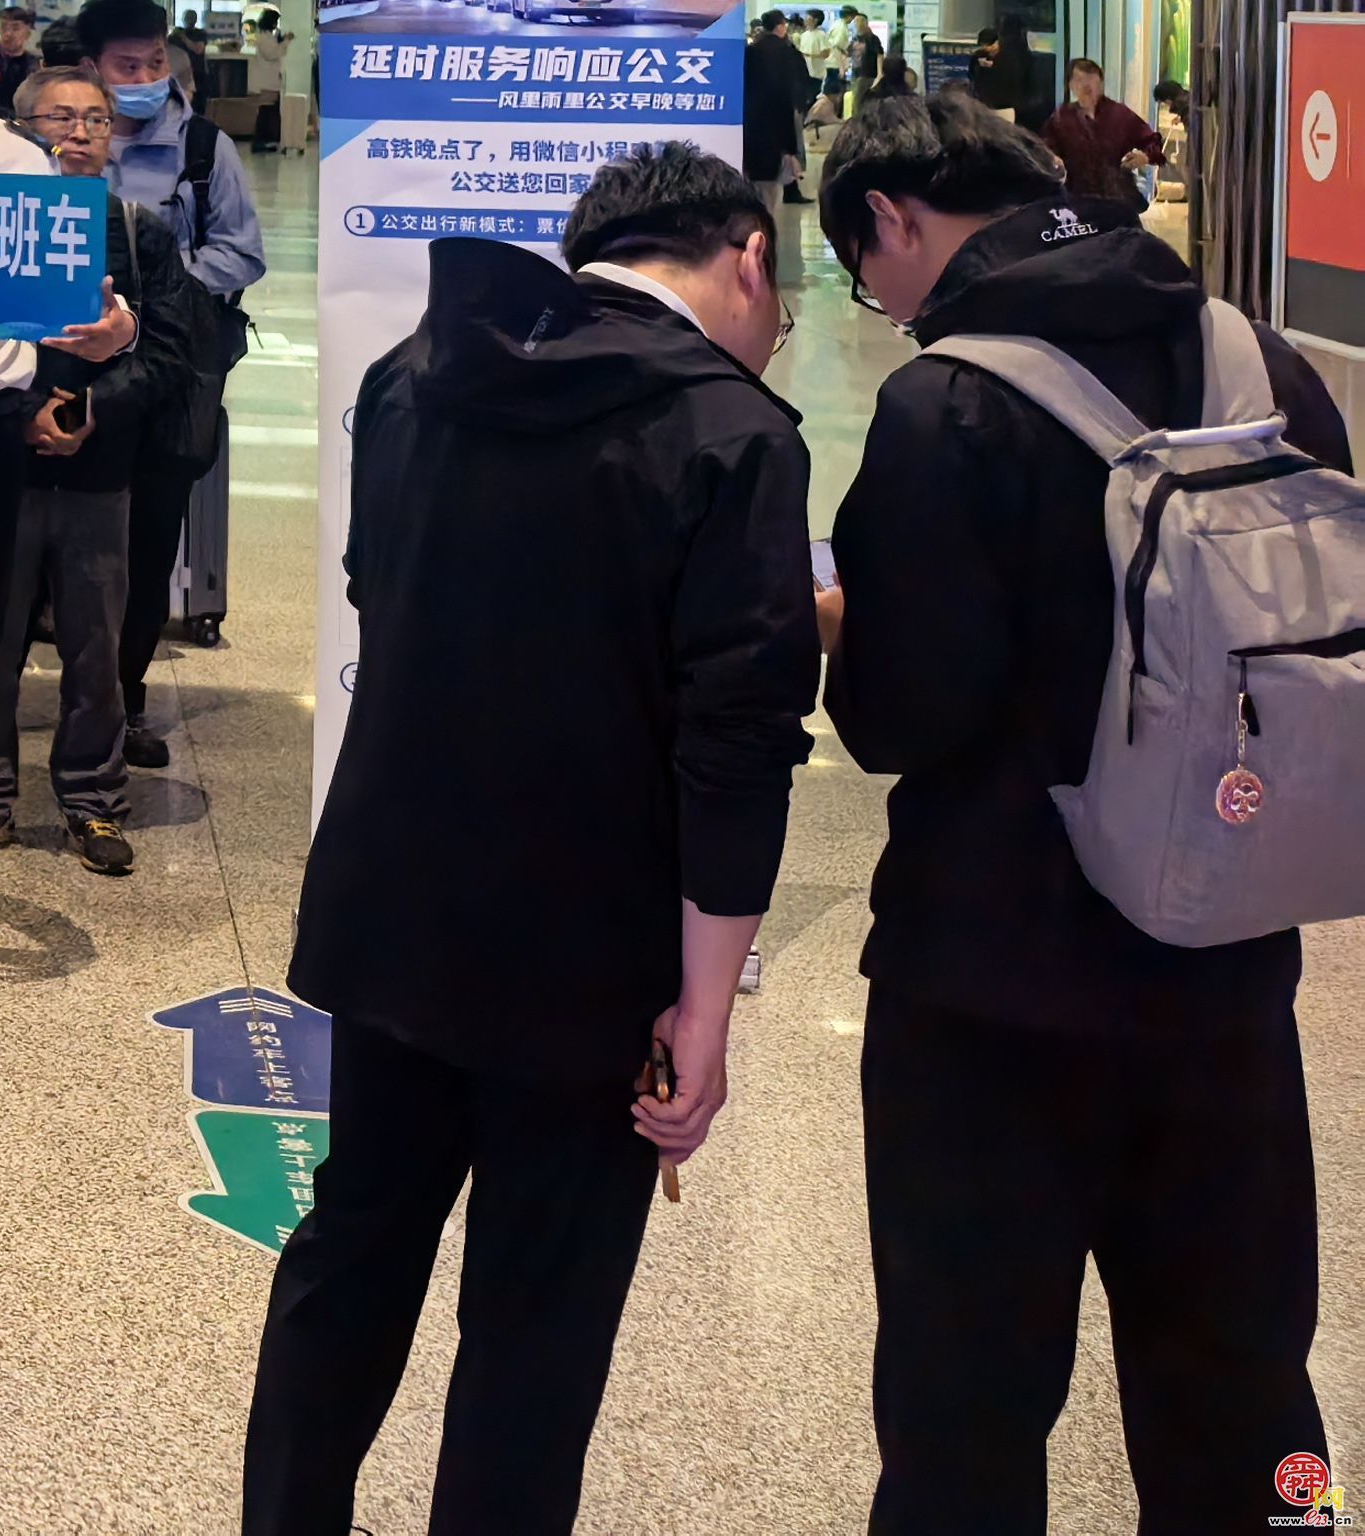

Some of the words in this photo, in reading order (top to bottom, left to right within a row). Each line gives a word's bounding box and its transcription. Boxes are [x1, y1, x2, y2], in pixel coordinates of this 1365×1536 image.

[349, 44, 715, 85] 延时服务响应公交
[1041, 223, 1098, 242] CAMEL
